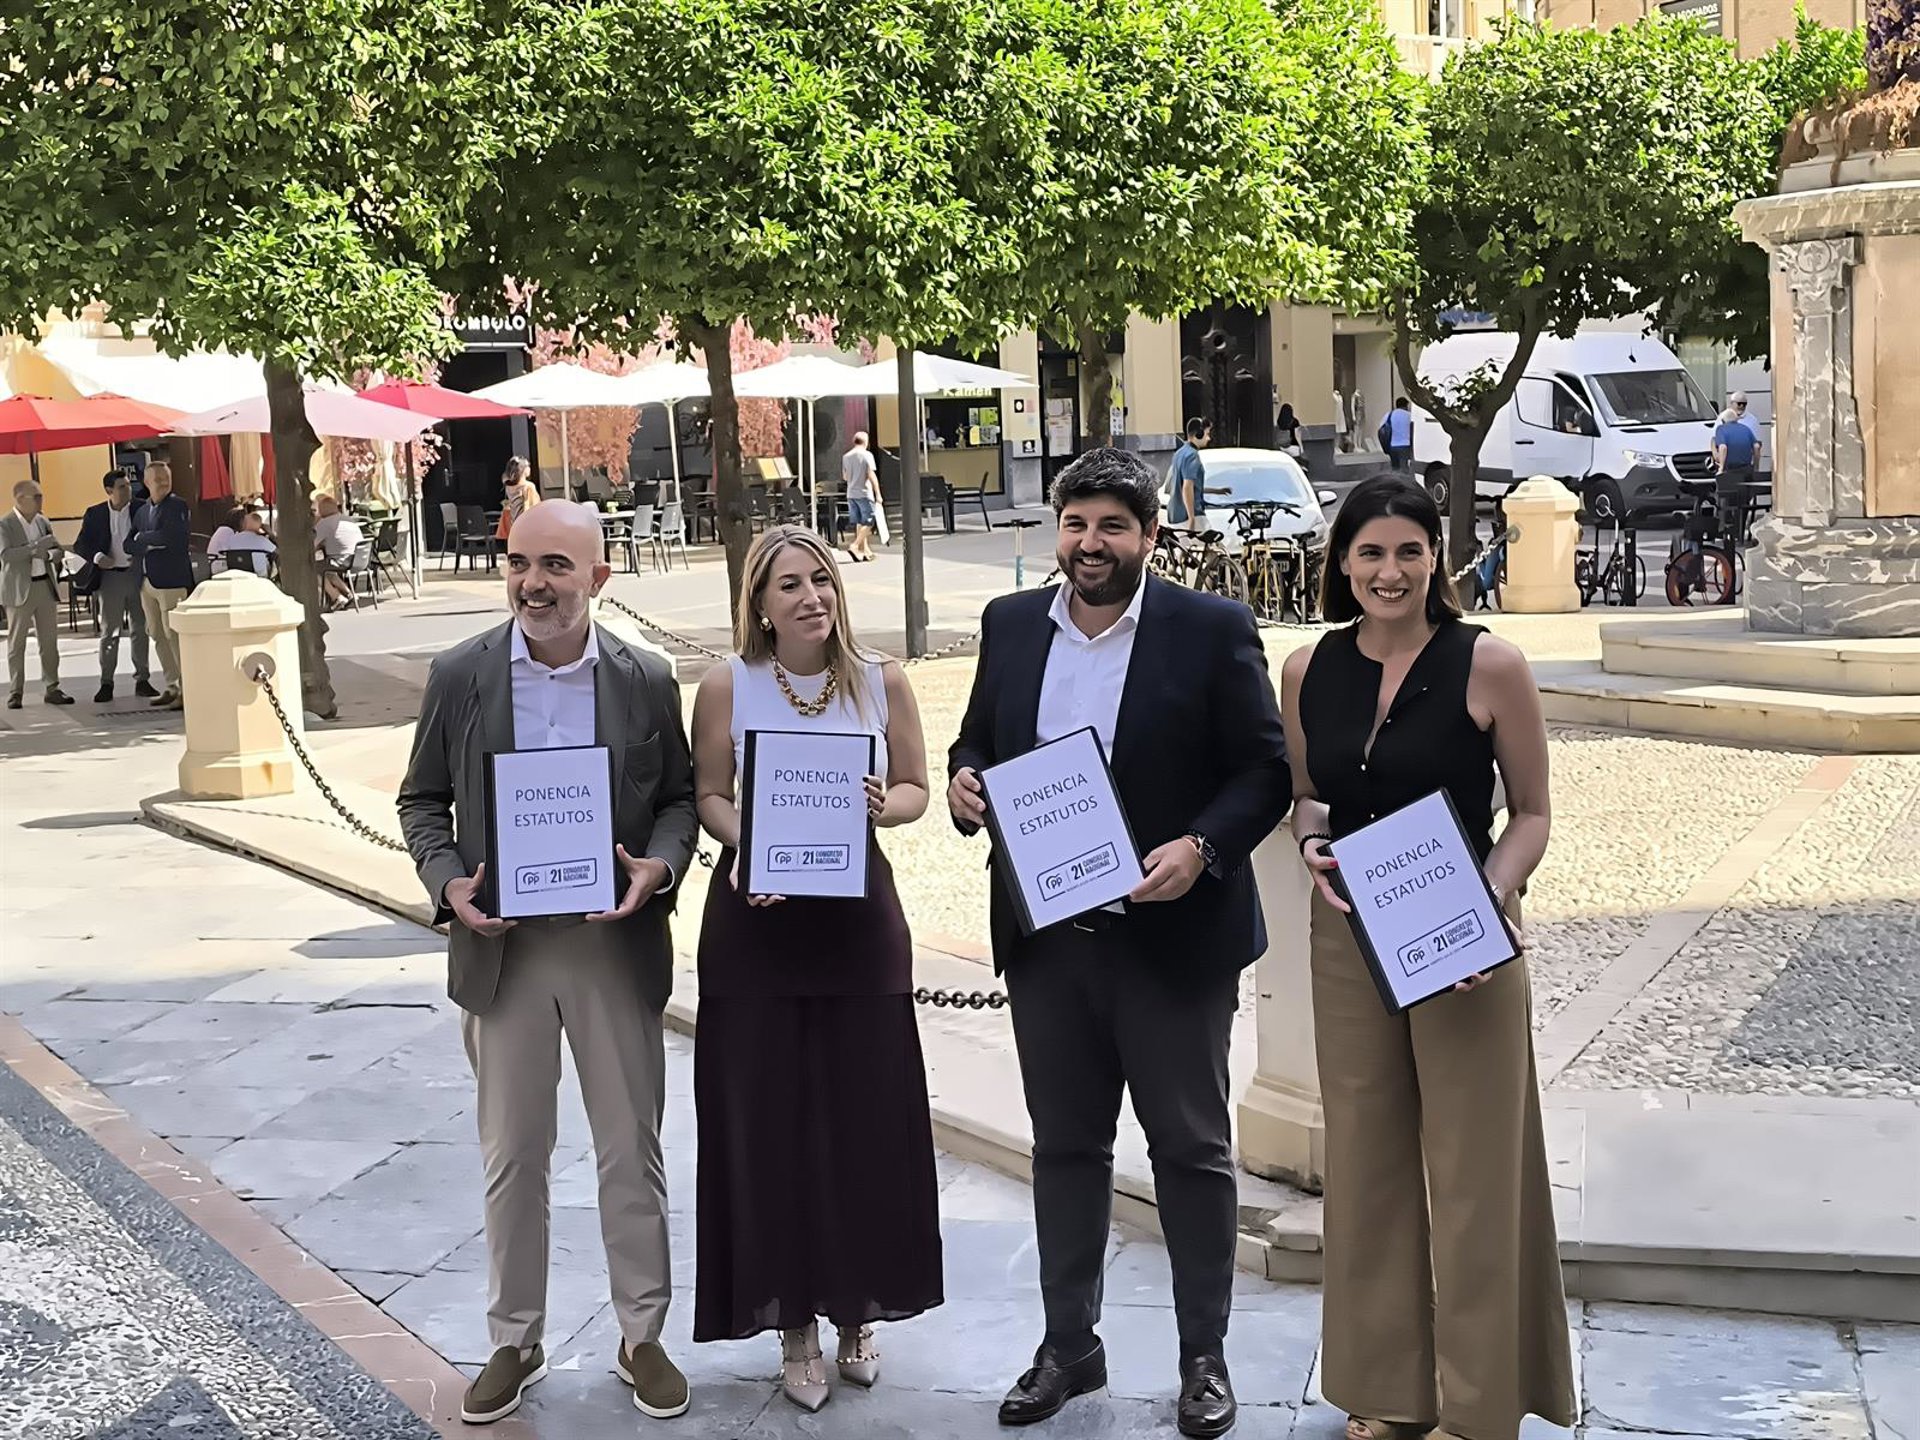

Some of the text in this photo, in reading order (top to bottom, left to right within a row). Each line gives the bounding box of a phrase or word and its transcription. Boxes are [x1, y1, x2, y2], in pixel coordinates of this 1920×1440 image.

[775, 769, 849, 784] PONENCIA
[515, 785, 591, 802] PONENCIA
[1012, 772, 1088, 812] PONENCIA
[771, 793, 850, 809] ESTATUTOS
[514, 810, 594, 827] ESTATUTOS
[1019, 795, 1098, 836] ESTATUTOS
[802, 851, 814, 864] 21
[1365, 838, 1443, 883] PONENCIA
[550, 868, 562, 884] 21
[1071, 862, 1085, 880] 21
[1374, 861, 1456, 909] ESTATUTOS
[1433, 933, 1448, 952] 21
